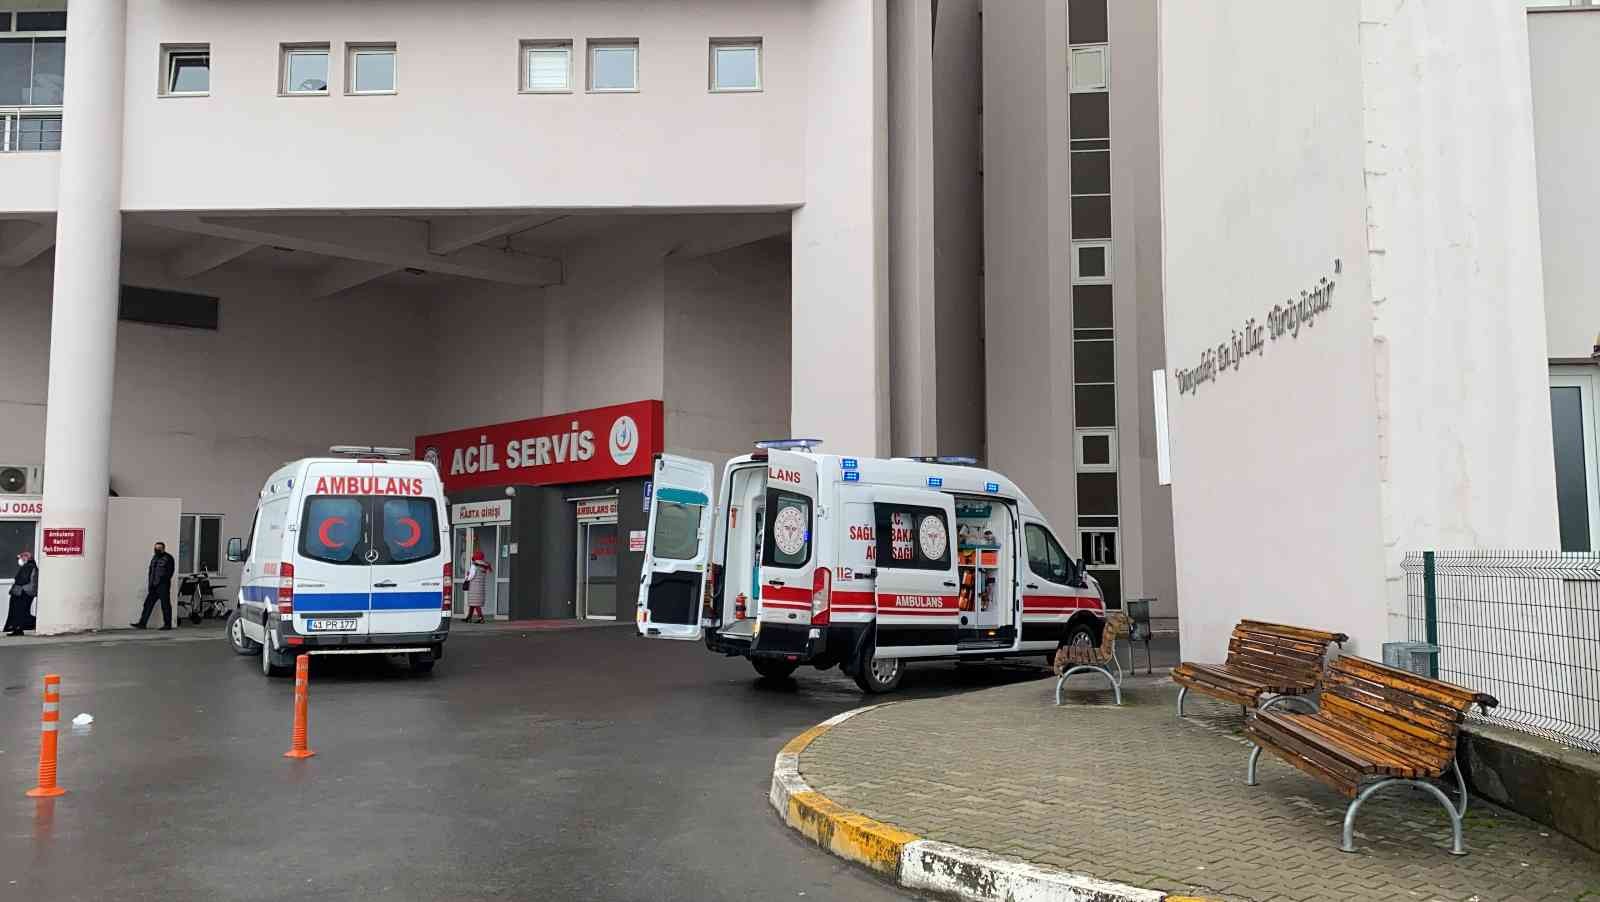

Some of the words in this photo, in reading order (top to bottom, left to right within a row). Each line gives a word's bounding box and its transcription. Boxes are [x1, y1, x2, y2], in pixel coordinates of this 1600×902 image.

[1217, 343, 1231, 371] En
[450, 434, 500, 475] ACİL
[506, 420, 595, 469] SERVİS
[768, 467, 801, 483] LANS
[316, 476, 423, 495] AMBULANS
[12, 503, 43, 513] ODAS
[849, 523, 876, 541] SAĞL
[836, 566, 853, 581] 112
[896, 595, 943, 608] AMBULANS
[313, 621, 322, 629] 41
[325, 620, 337, 629] PR
[340, 620, 355, 629] 177
